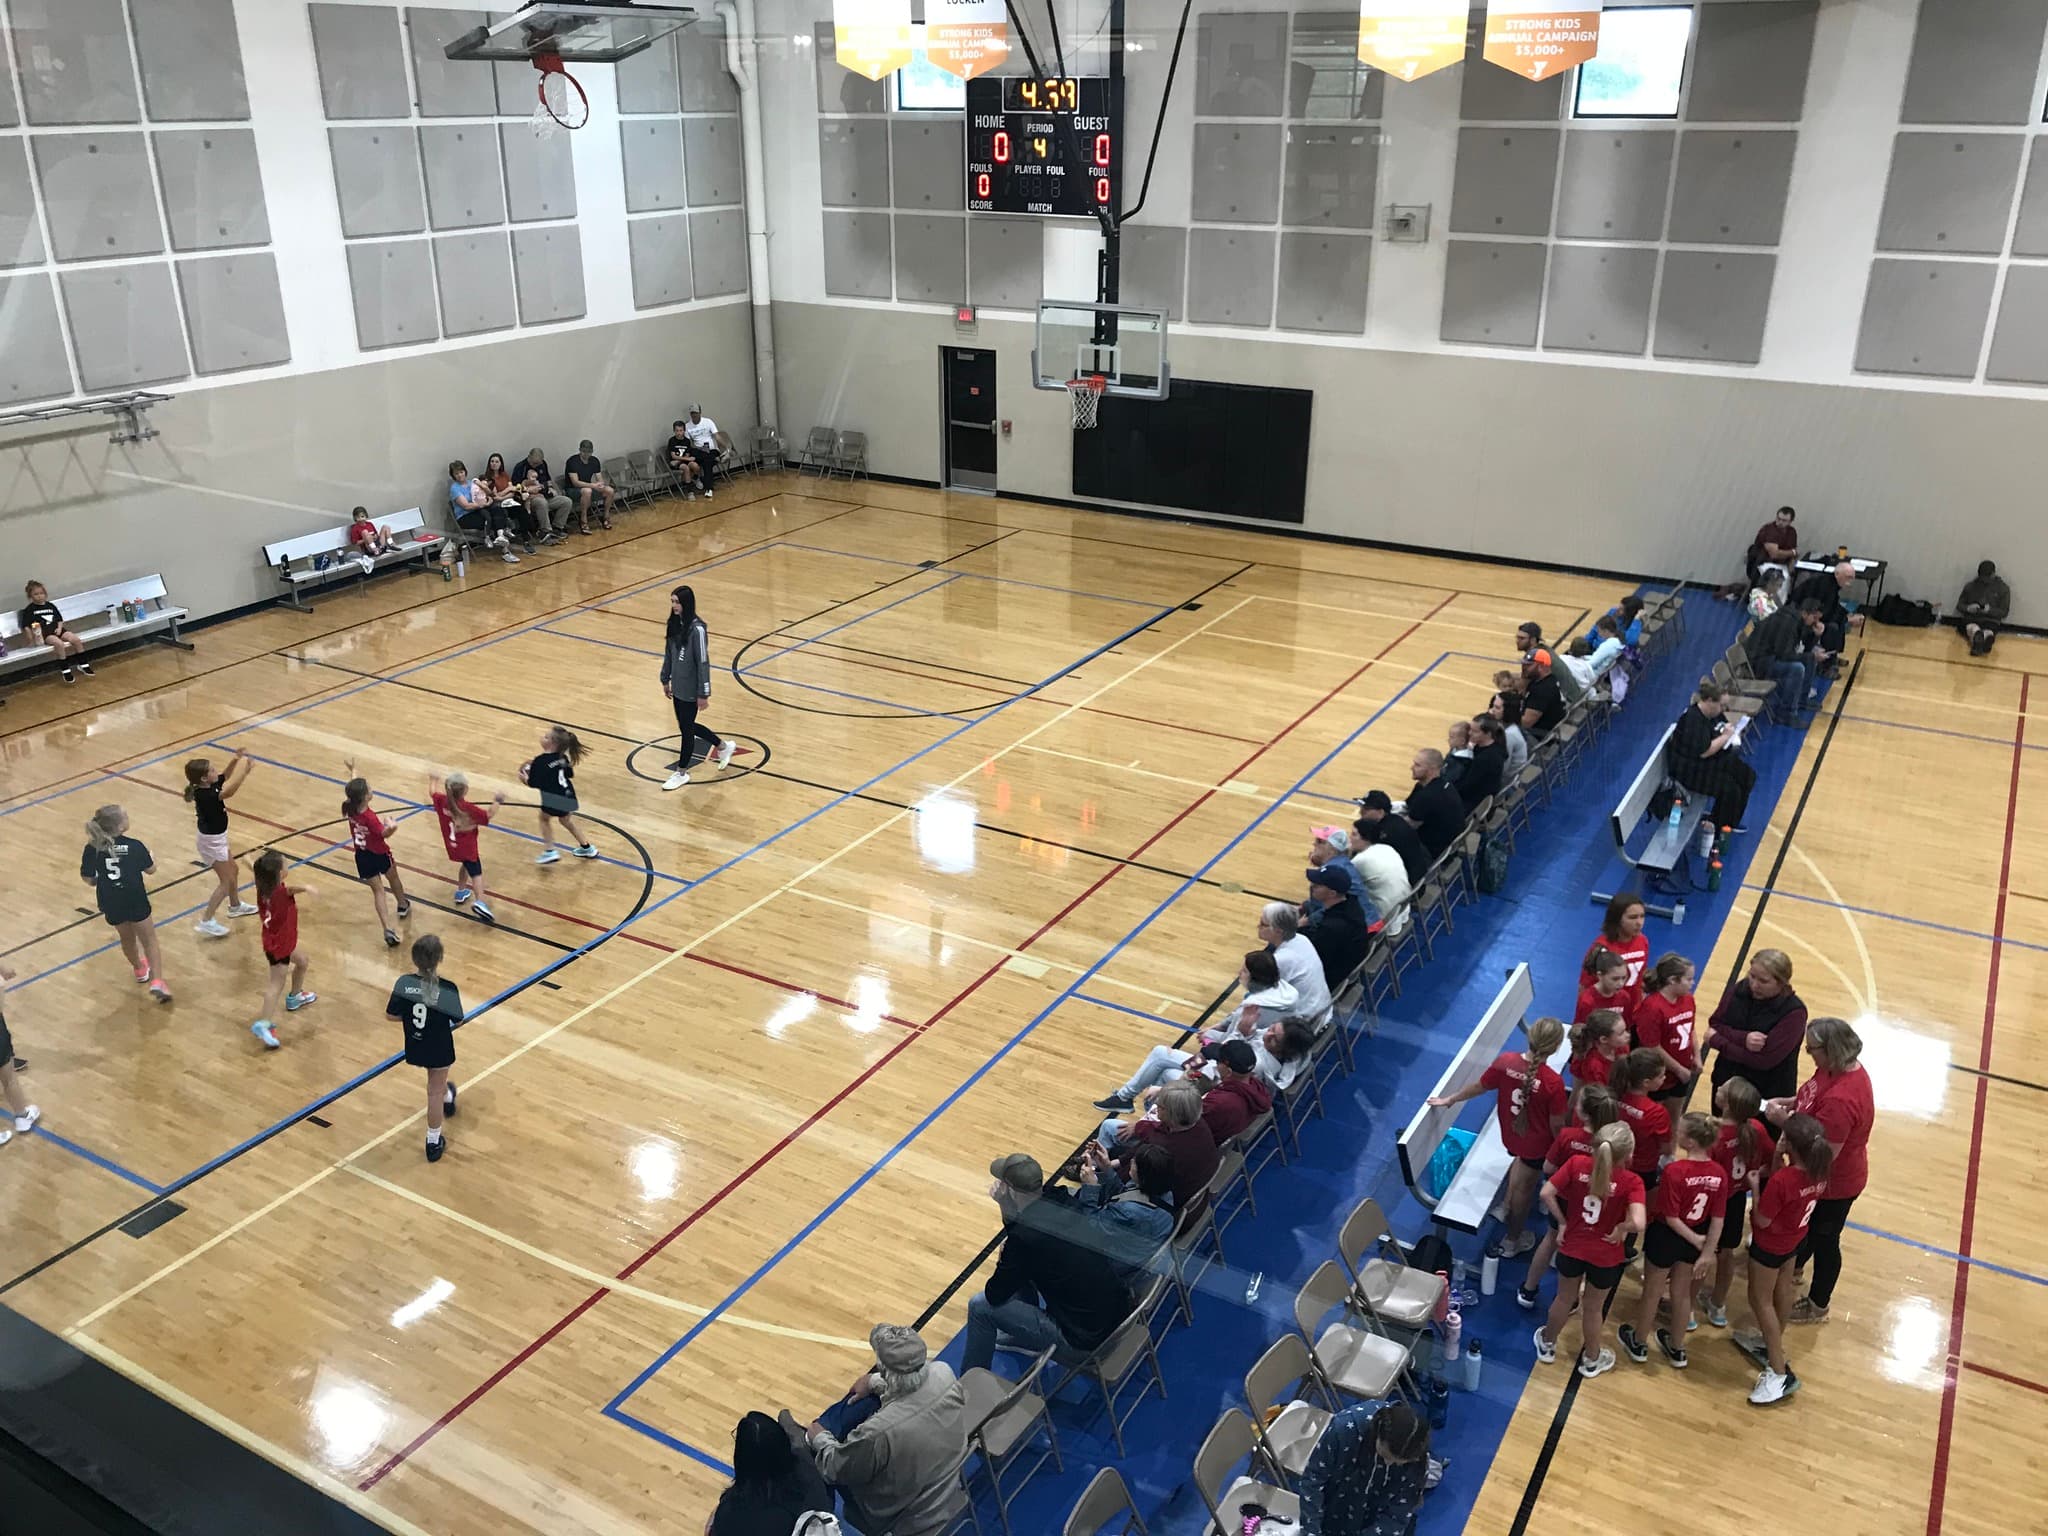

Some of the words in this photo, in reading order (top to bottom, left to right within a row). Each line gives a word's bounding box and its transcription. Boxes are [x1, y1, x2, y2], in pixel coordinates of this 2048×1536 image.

[1505, 19, 1551, 30] STRONG
[1554, 18, 1581, 29] KIDS
[974, 28, 993, 37] KIDS
[1536, 31, 1597, 42] CAMPAIGN
[1515, 45, 1565, 56] $5,000+
[975, 115, 1006, 128] HOME
[1026, 123, 1054, 133] PERIOD
[1074, 116, 1109, 130] GUEST
[994, 132, 1009, 161] 0
[1033, 138, 1046, 158] 4
[1096, 134, 1110, 164] 0
[970, 163, 993, 173] FOULS
[1015, 165, 1042, 174] PLAYER
[1046, 166, 1066, 176] FOUL
[979, 174, 990, 196] 0
[1097, 178, 1109, 201] 0
[970, 200, 993, 210] SCORE
[1027, 203, 1053, 213] MATCH
[1151, 321, 1158, 330] 2
[105, 858, 121, 880] 5
[412, 1003, 427, 1029] 9
[1581, 1194, 1602, 1225] 9
[1686, 1193, 1709, 1221] 3
[1799, 1199, 1817, 1228] 2
